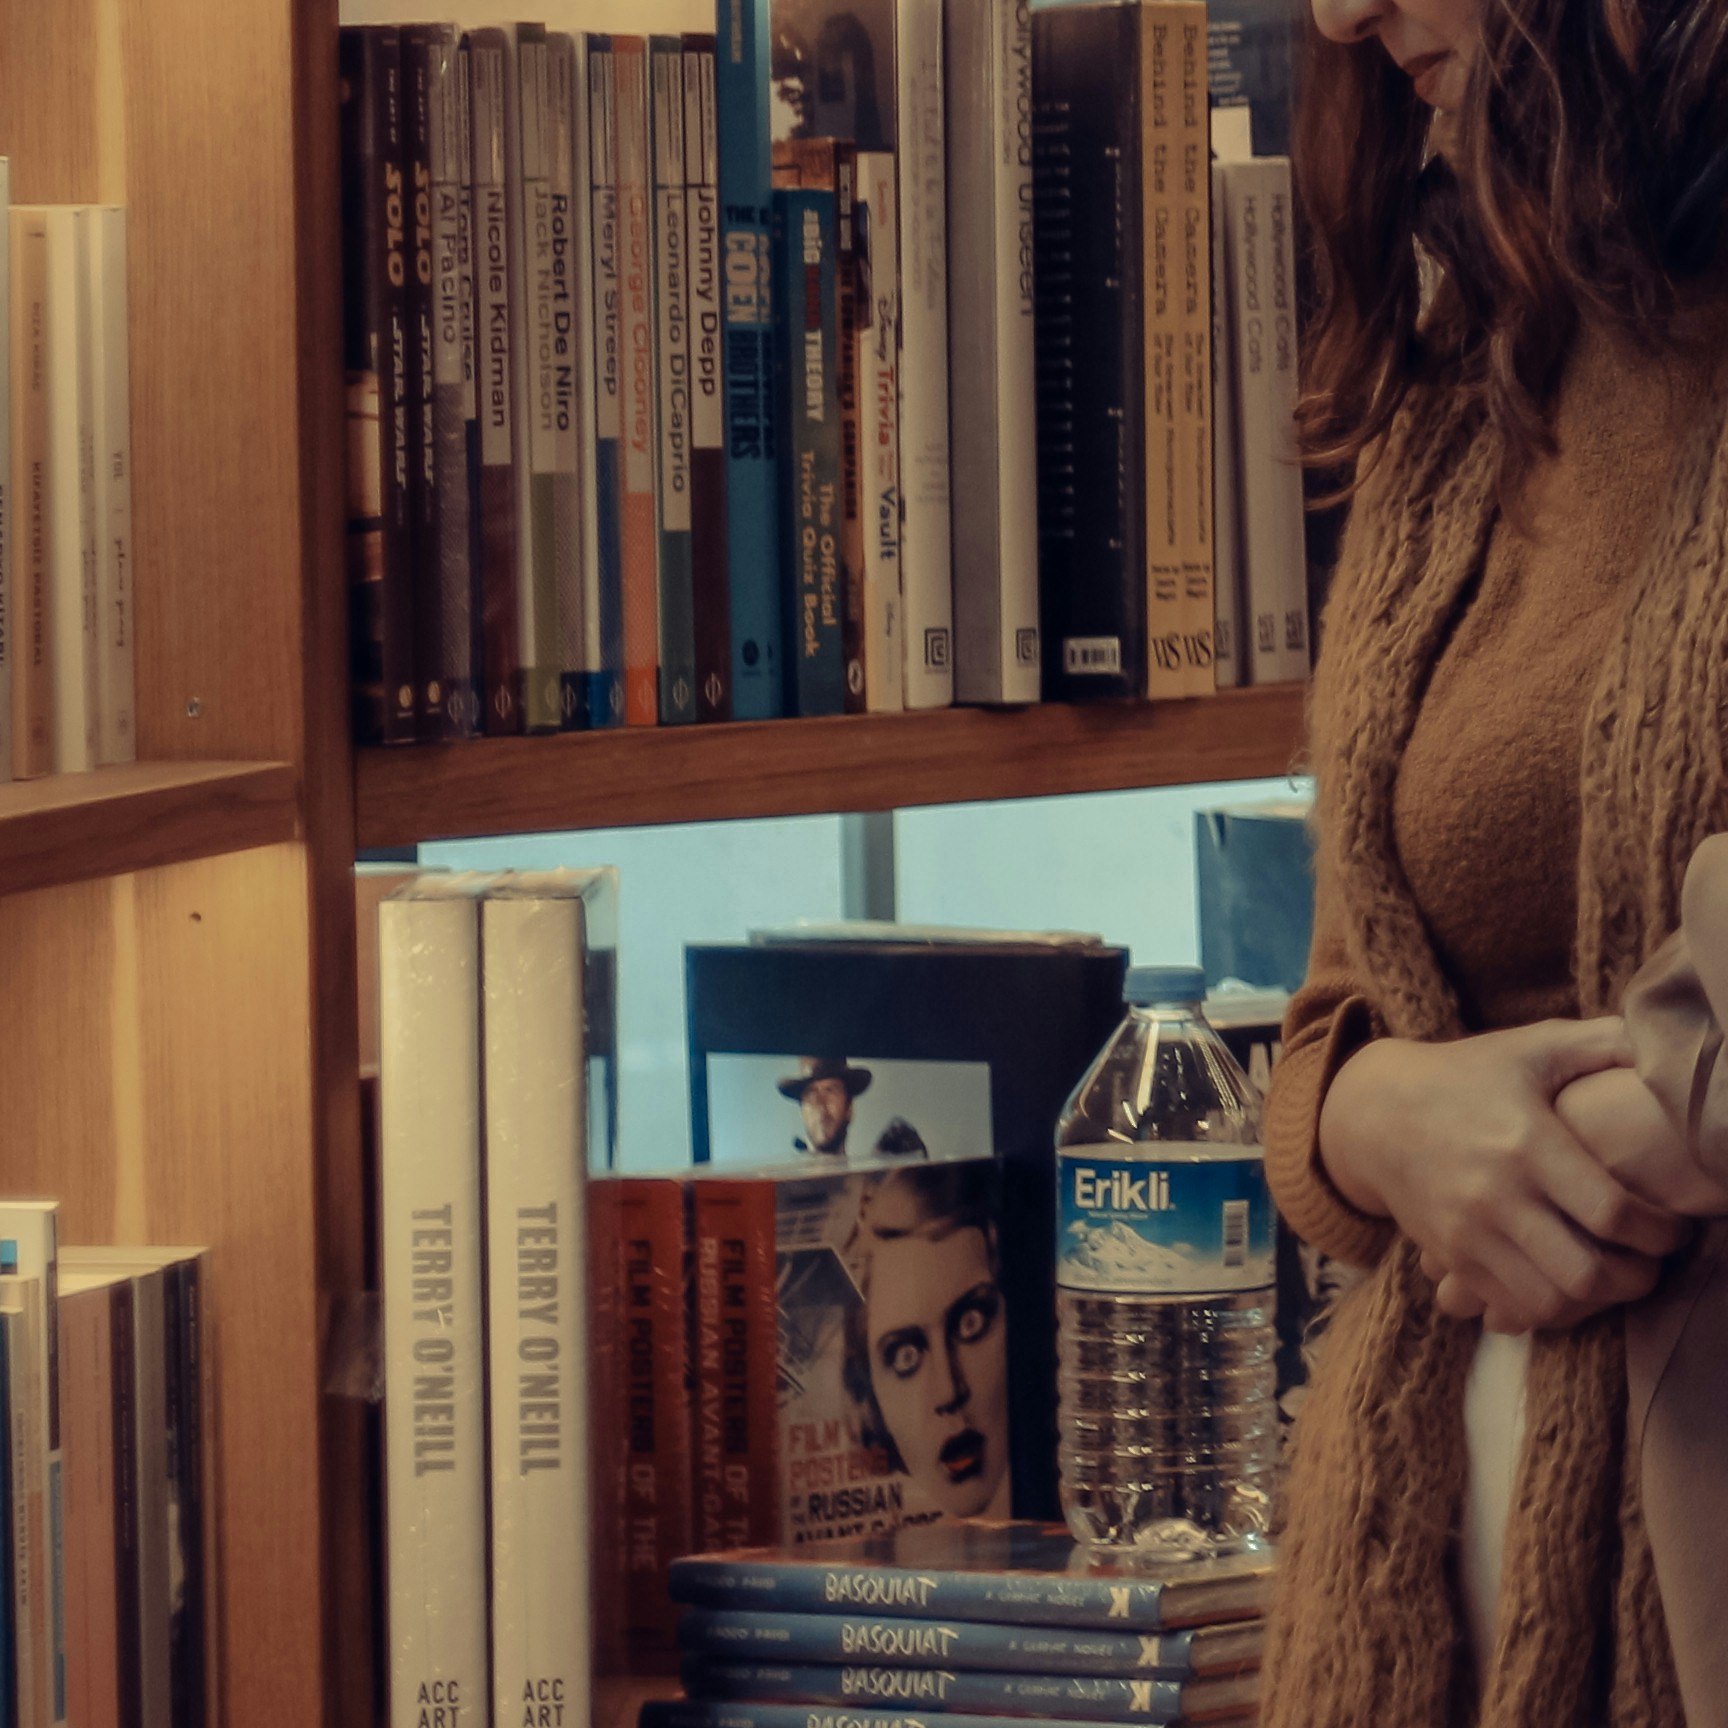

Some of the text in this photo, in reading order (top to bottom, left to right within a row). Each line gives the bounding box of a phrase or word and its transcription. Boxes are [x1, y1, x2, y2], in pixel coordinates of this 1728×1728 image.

[1183, 23, 1199, 129] Behind
[385, 160, 405, 287] SOLO
[414, 160, 432, 284] SOLO
[1152, 23, 1170, 318] Behind the Camera
[1184, 143, 1199, 194] the
[439, 192, 457, 344] Al Pacino
[487, 190, 508, 429] Nicole Kidman
[534, 187, 556, 432] Jack Nicholson
[550, 191, 573, 433] Robert De Niro
[600, 193, 621, 398] Meryl Streep
[627, 195, 650, 455] George Clooney
[696, 189, 719, 398] Johnny Depp
[1184, 207, 1201, 316] Camera
[666, 193, 688, 494] Leonardo DiCaprio
[726, 229, 761, 460] COEN BROTHERS
[804, 329, 825, 422] THEORY
[878, 365, 898, 562] Trivia Vault
[800, 451, 819, 658] Trivia Quiz Book
[819, 483, 837, 626] The Official
[1072, 1167, 1172, 1212] Erikli
[412, 1202, 455, 1478] TERRY O'NEILL
[518, 1202, 561, 1477] TERRY O'NEILL
[631, 1238, 656, 1504] FILM POSTERS OF
[700, 1235, 721, 1371] RUSSIAN
[722, 1238, 748, 1503] FILM POSTERS OF
[788, 1420, 840, 1454] FILM
[808, 1481, 904, 1523] RUSSIAN
[824, 1572, 939, 1608] BASQUIAT
[840, 1623, 960, 1659] BASQUIAT
[416, 1678, 461, 1706] ACC
[522, 1678, 567, 1703] ACC
[840, 1668, 958, 1701] BASQUIAT
